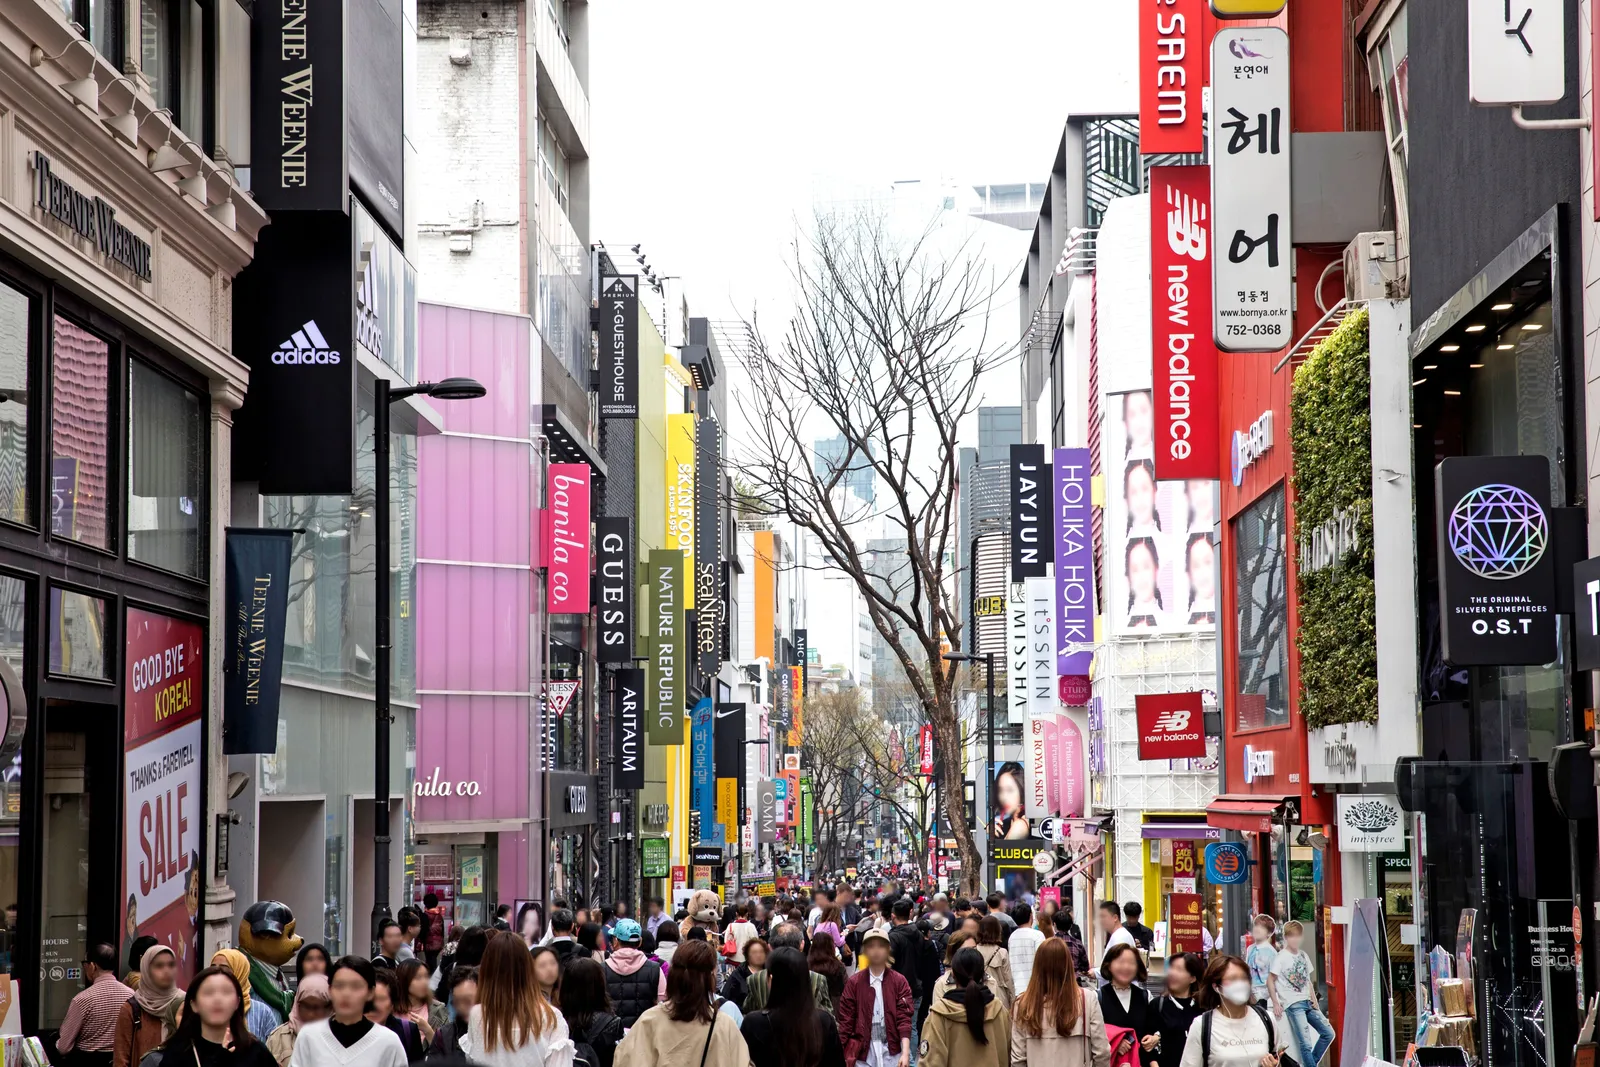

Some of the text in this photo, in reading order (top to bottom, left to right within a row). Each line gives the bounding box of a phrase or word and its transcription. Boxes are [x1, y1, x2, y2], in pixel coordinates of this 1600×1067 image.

[1233, 65, 1269, 79] 본연애
[281, 64, 312, 188] WEENIE
[30, 150, 153, 282] TEENIE WEENIE
[1220, 307, 1288, 318] www.bornya.or.kr
[1237, 290, 1269, 303] 명동점
[614, 300, 624, 402] K-GUESTHOUSE
[1226, 324, 1281, 336] 752-0368
[271, 347, 340, 365] adidas
[1167, 265, 1195, 460] new balance
[1020, 463, 1038, 564] JAYJUN
[1062, 466, 1084, 557] HOLIKA
[553, 475, 584, 605] banila co.
[602, 533, 625, 645] GUESS
[700, 563, 716, 652] seaNtree
[1495, 605, 1547, 613] TIMEPIECES
[246, 573, 271, 705] TEENIE WEENIE
[659, 566, 673, 728] NATURE REPUBLIC
[1471, 618, 1532, 635] O.S.T
[132, 643, 184, 693] GOOD BYE
[1063, 686, 1088, 694] ETUDE
[155, 677, 192, 722] KOREA!
[622, 687, 637, 772] ARITAUM
[1145, 732, 1199, 743] new balance
[130, 764, 157, 793] THANKS
[162, 743, 194, 778] FAREWELL
[694, 729, 709, 785] 바오로딸
[1034, 740, 1044, 807] ROYAL SKIN
[1065, 741, 1075, 804] Princess House
[456, 781, 482, 796] co.
[763, 792, 773, 832] OMM
[139, 781, 188, 897] SALE
[1176, 848, 1192, 857] SALE
[1350, 834, 1395, 844] innisfree
[464, 865, 481, 874] sale
[1175, 856, 1193, 872] 50
[42, 938, 69, 946] HOURS
[1229, 1038, 1263, 1047] Columbia
